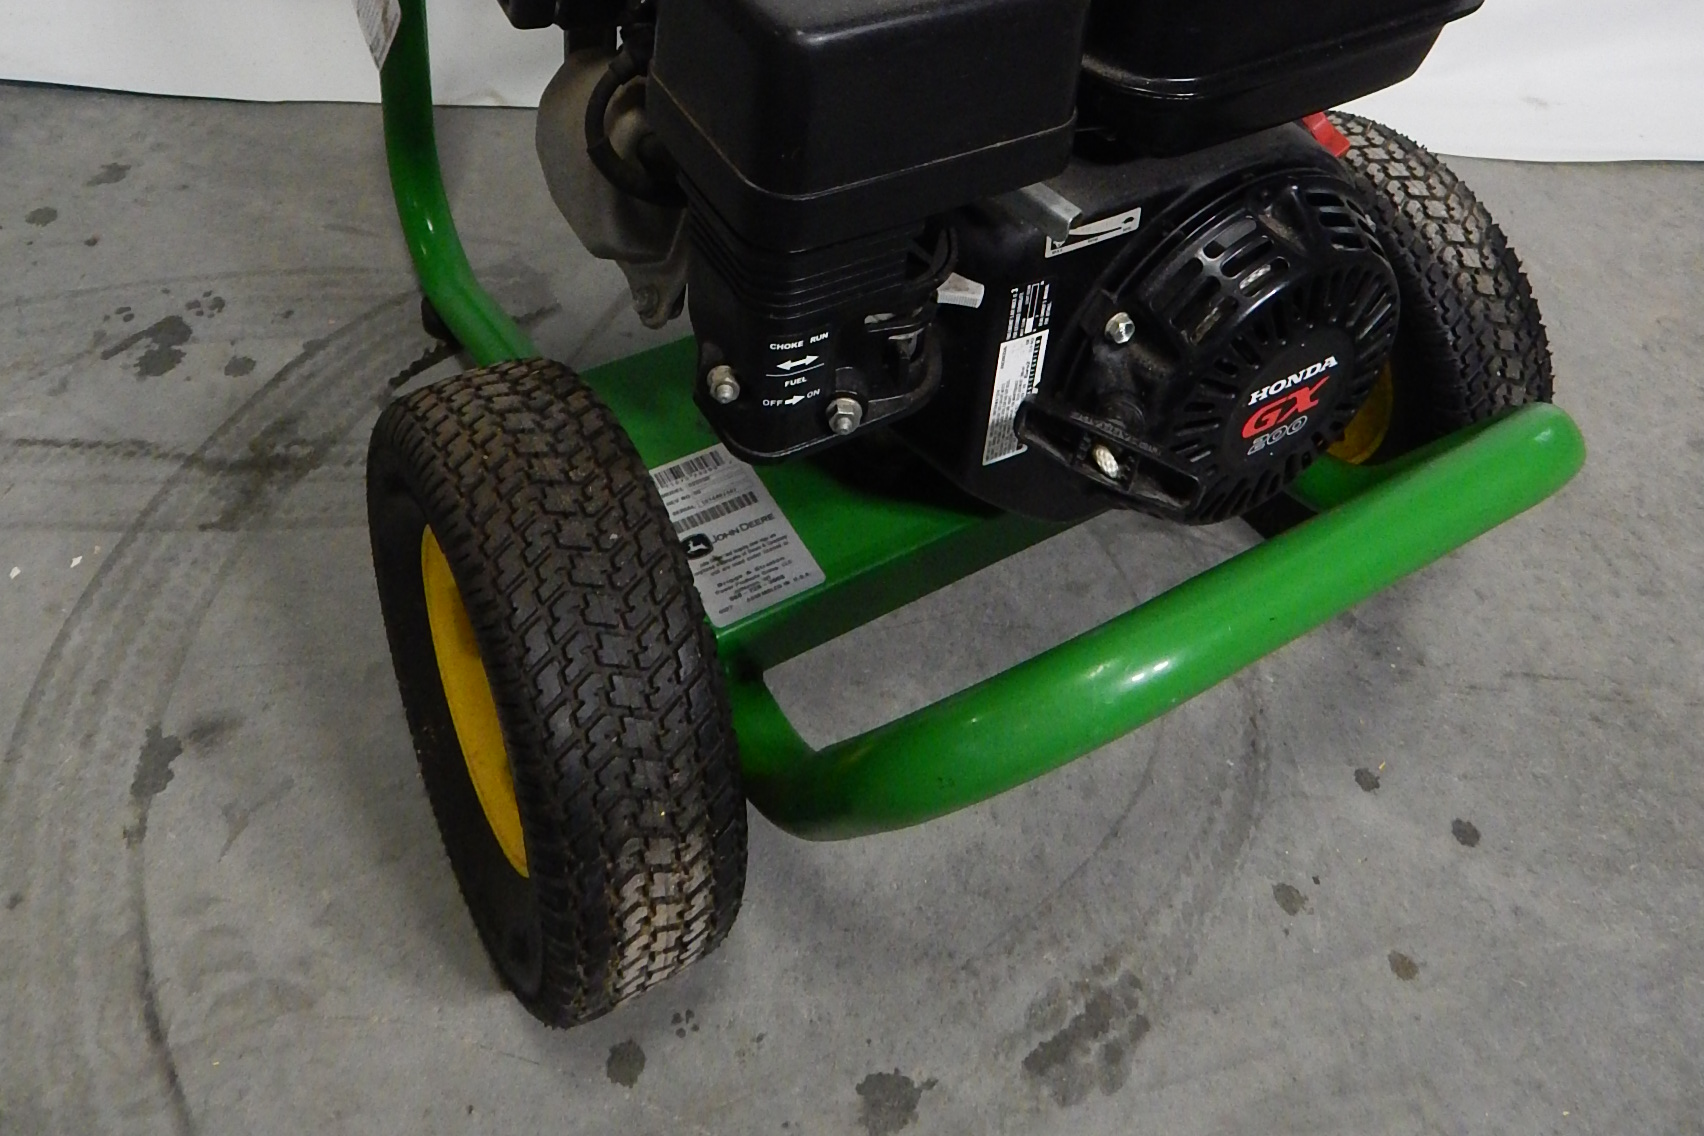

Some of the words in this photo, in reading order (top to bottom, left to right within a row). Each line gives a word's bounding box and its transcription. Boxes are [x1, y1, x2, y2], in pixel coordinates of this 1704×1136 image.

[769, 340, 804, 350] CHOKE
[810, 332, 829, 343] RUN
[784, 376, 807, 387] FUEL
[806, 389, 820, 398] ON
[1248, 355, 1338, 406] HONDA
[1241, 375, 1330, 439] GX
[1247, 415, 1308, 456] 200
[709, 526, 739, 544] JOHN
[738, 512, 775, 532] DEERE
